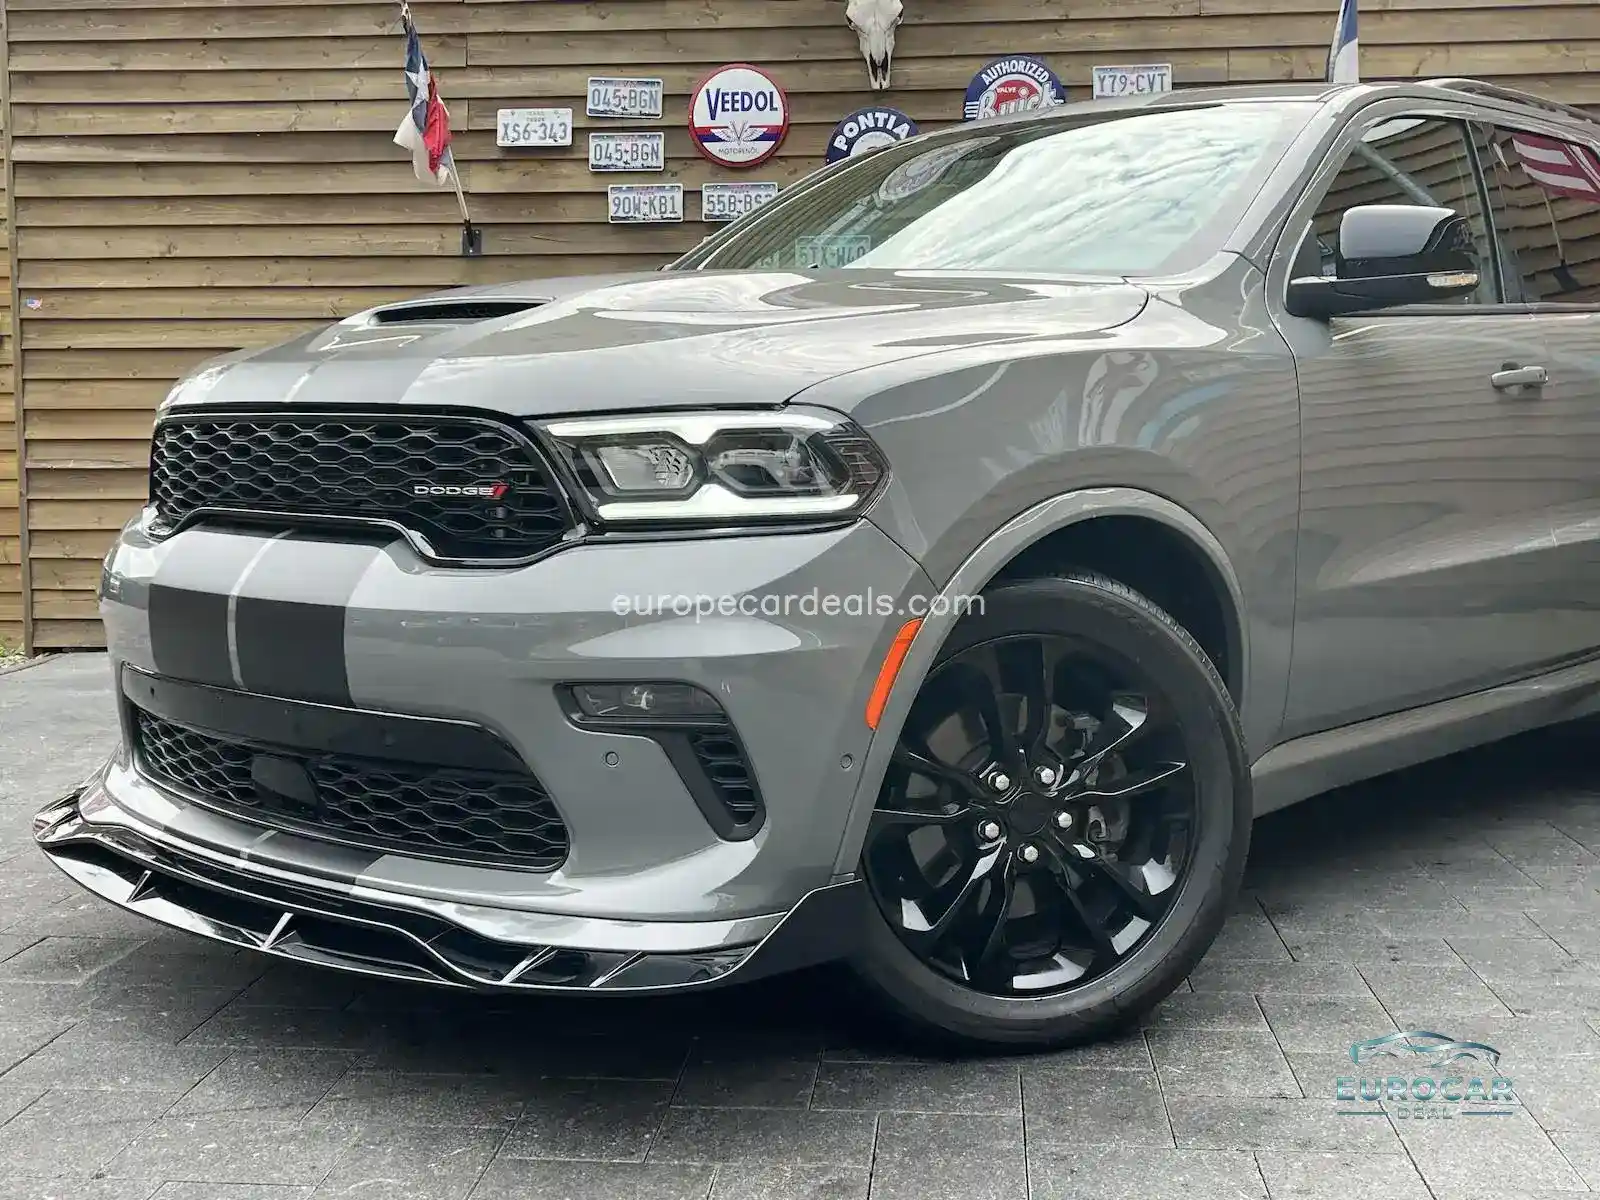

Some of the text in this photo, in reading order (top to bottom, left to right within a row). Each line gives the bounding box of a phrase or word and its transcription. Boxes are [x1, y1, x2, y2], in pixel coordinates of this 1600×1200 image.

[981, 59, 1050, 86] AUTHORIZED
[996, 86, 1017, 94] VALVE
[705, 87, 779, 121] VEEDOL
[502, 122, 568, 142] XS6-343
[833, 111, 911, 151] PONTIA
[706, 193, 773, 213] 55B-BS
[413, 485, 495, 496] DODGE
